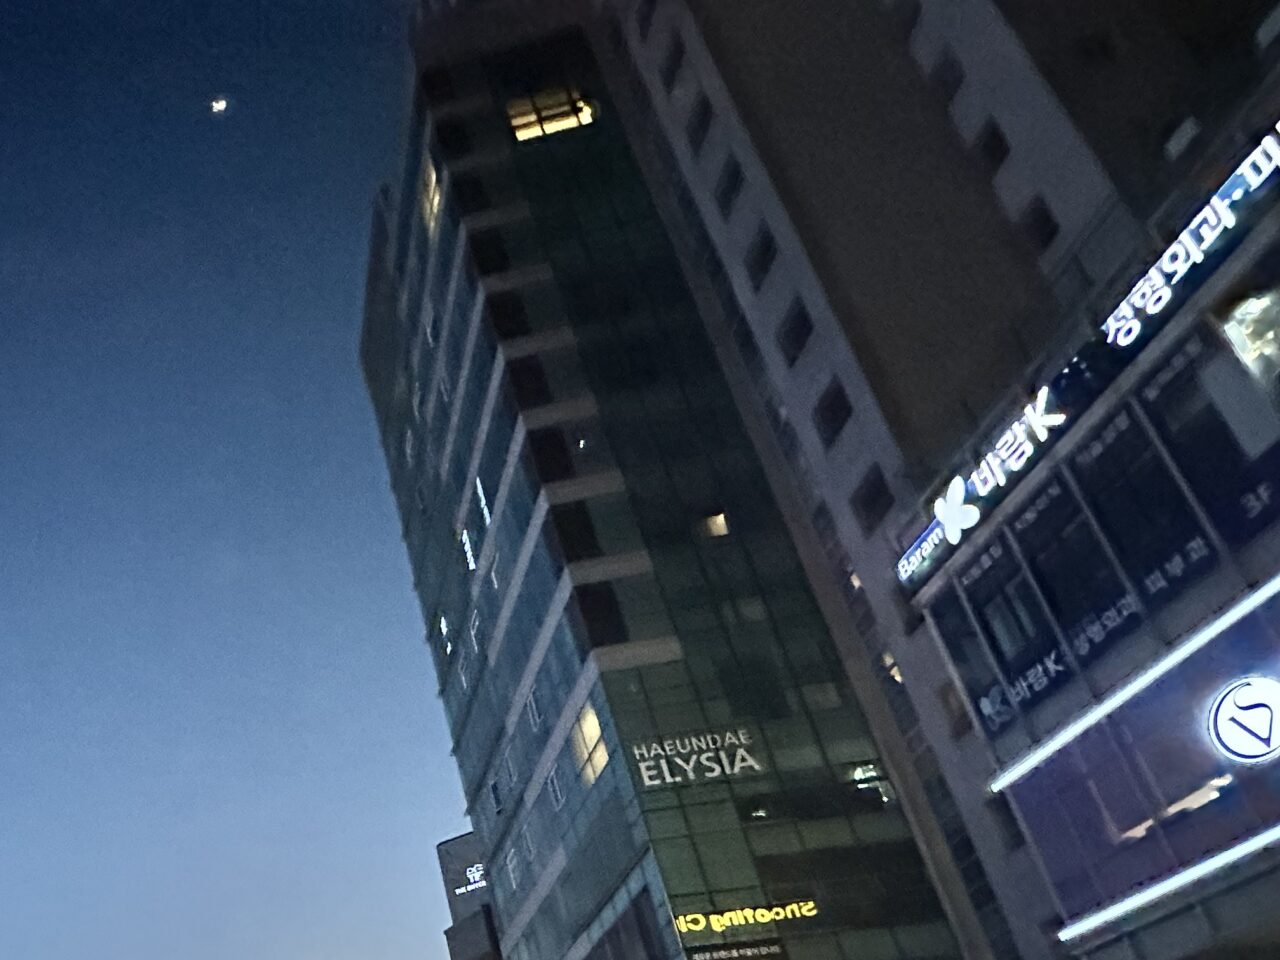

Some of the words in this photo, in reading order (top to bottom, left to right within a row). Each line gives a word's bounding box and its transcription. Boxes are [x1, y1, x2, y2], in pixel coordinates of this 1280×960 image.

[896, 526, 946, 583] Baram
[969, 385, 1067, 497] 바람K
[632, 728, 753, 760] HAEUNDAE
[637, 747, 762, 787] ELYSIA
